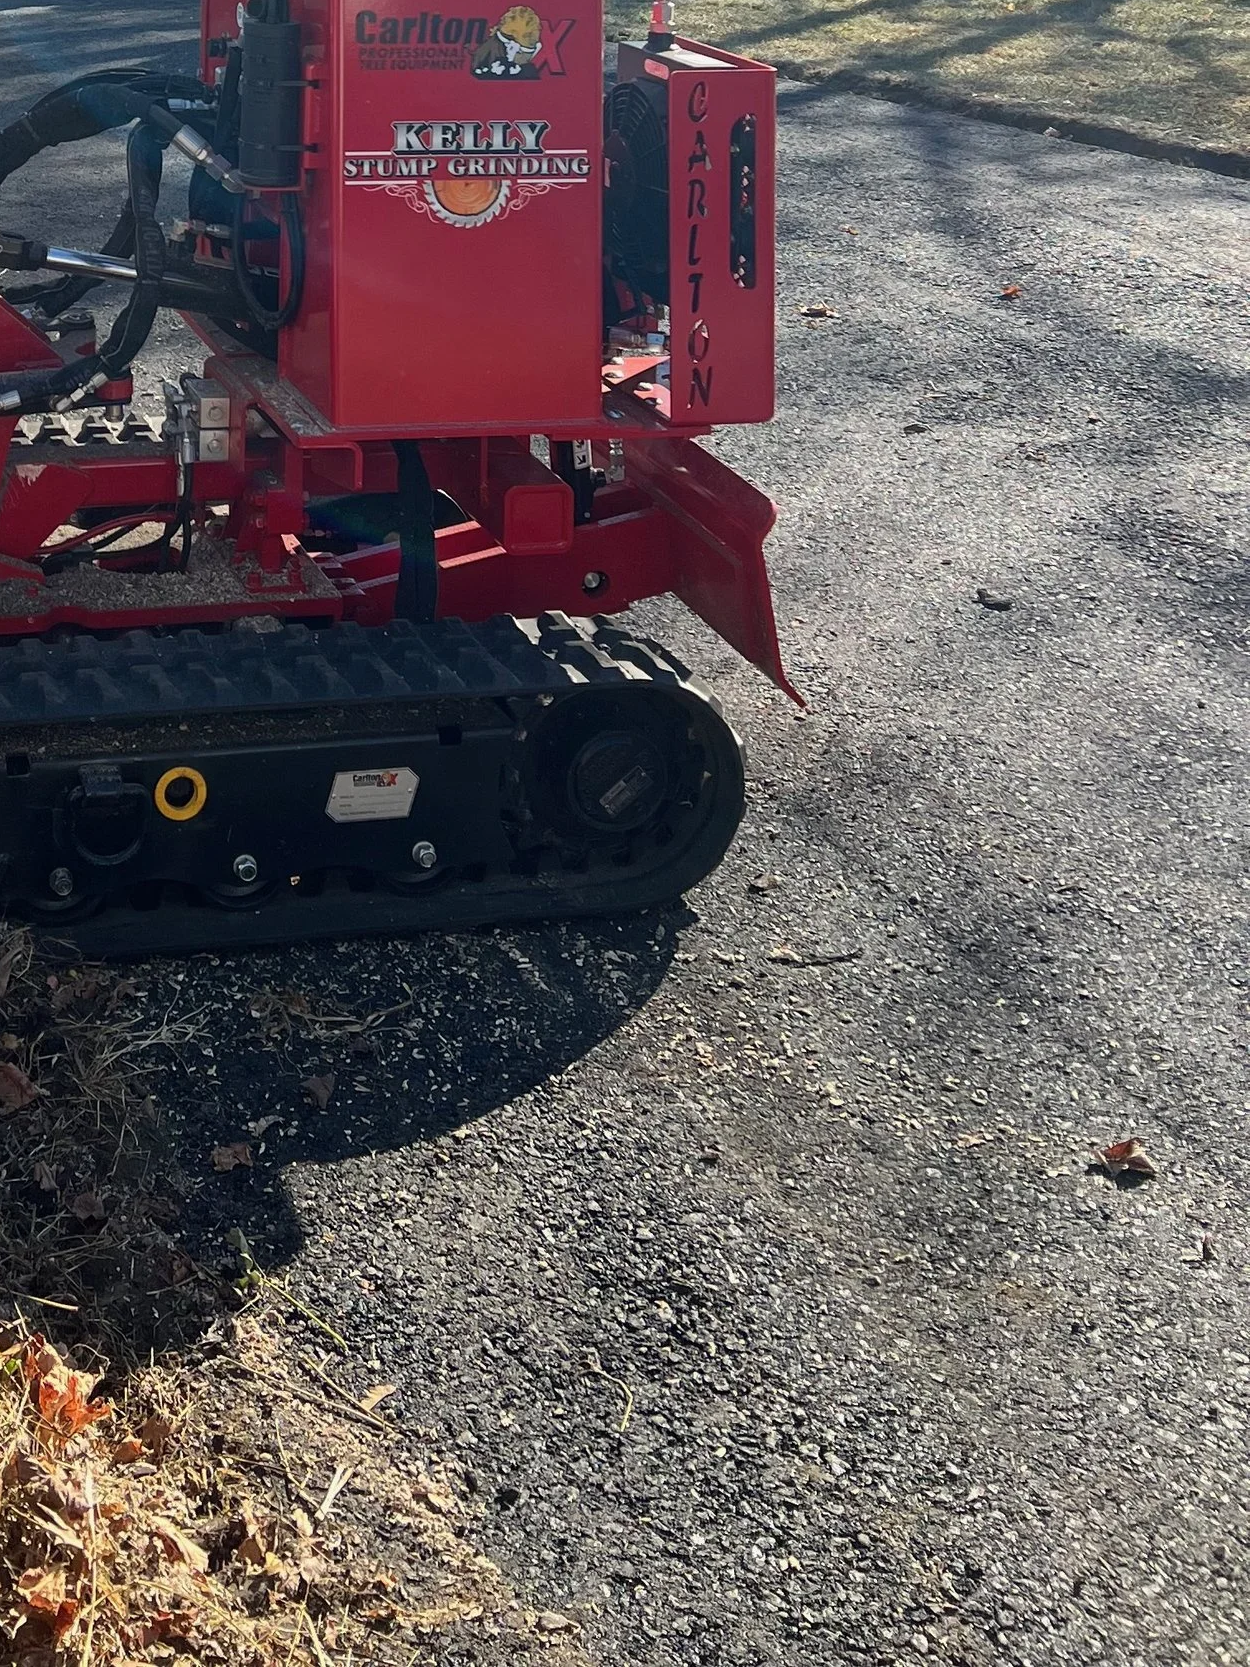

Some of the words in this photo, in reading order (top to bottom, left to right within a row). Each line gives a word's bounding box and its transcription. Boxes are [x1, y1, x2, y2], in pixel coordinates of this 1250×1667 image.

[355, 10, 488, 45] Carlton
[359, 47, 465, 59] PROFESSIONAL
[360, 59, 388, 70] TREE
[391, 59, 465, 70] EQUIPMENT
[391, 120, 550, 157] KELLY
[343, 158, 437, 178] STUMP
[447, 157, 591, 177] GRINDING
[688, 81, 712, 409] CARLTON
[352, 773, 380, 783] Carlton
